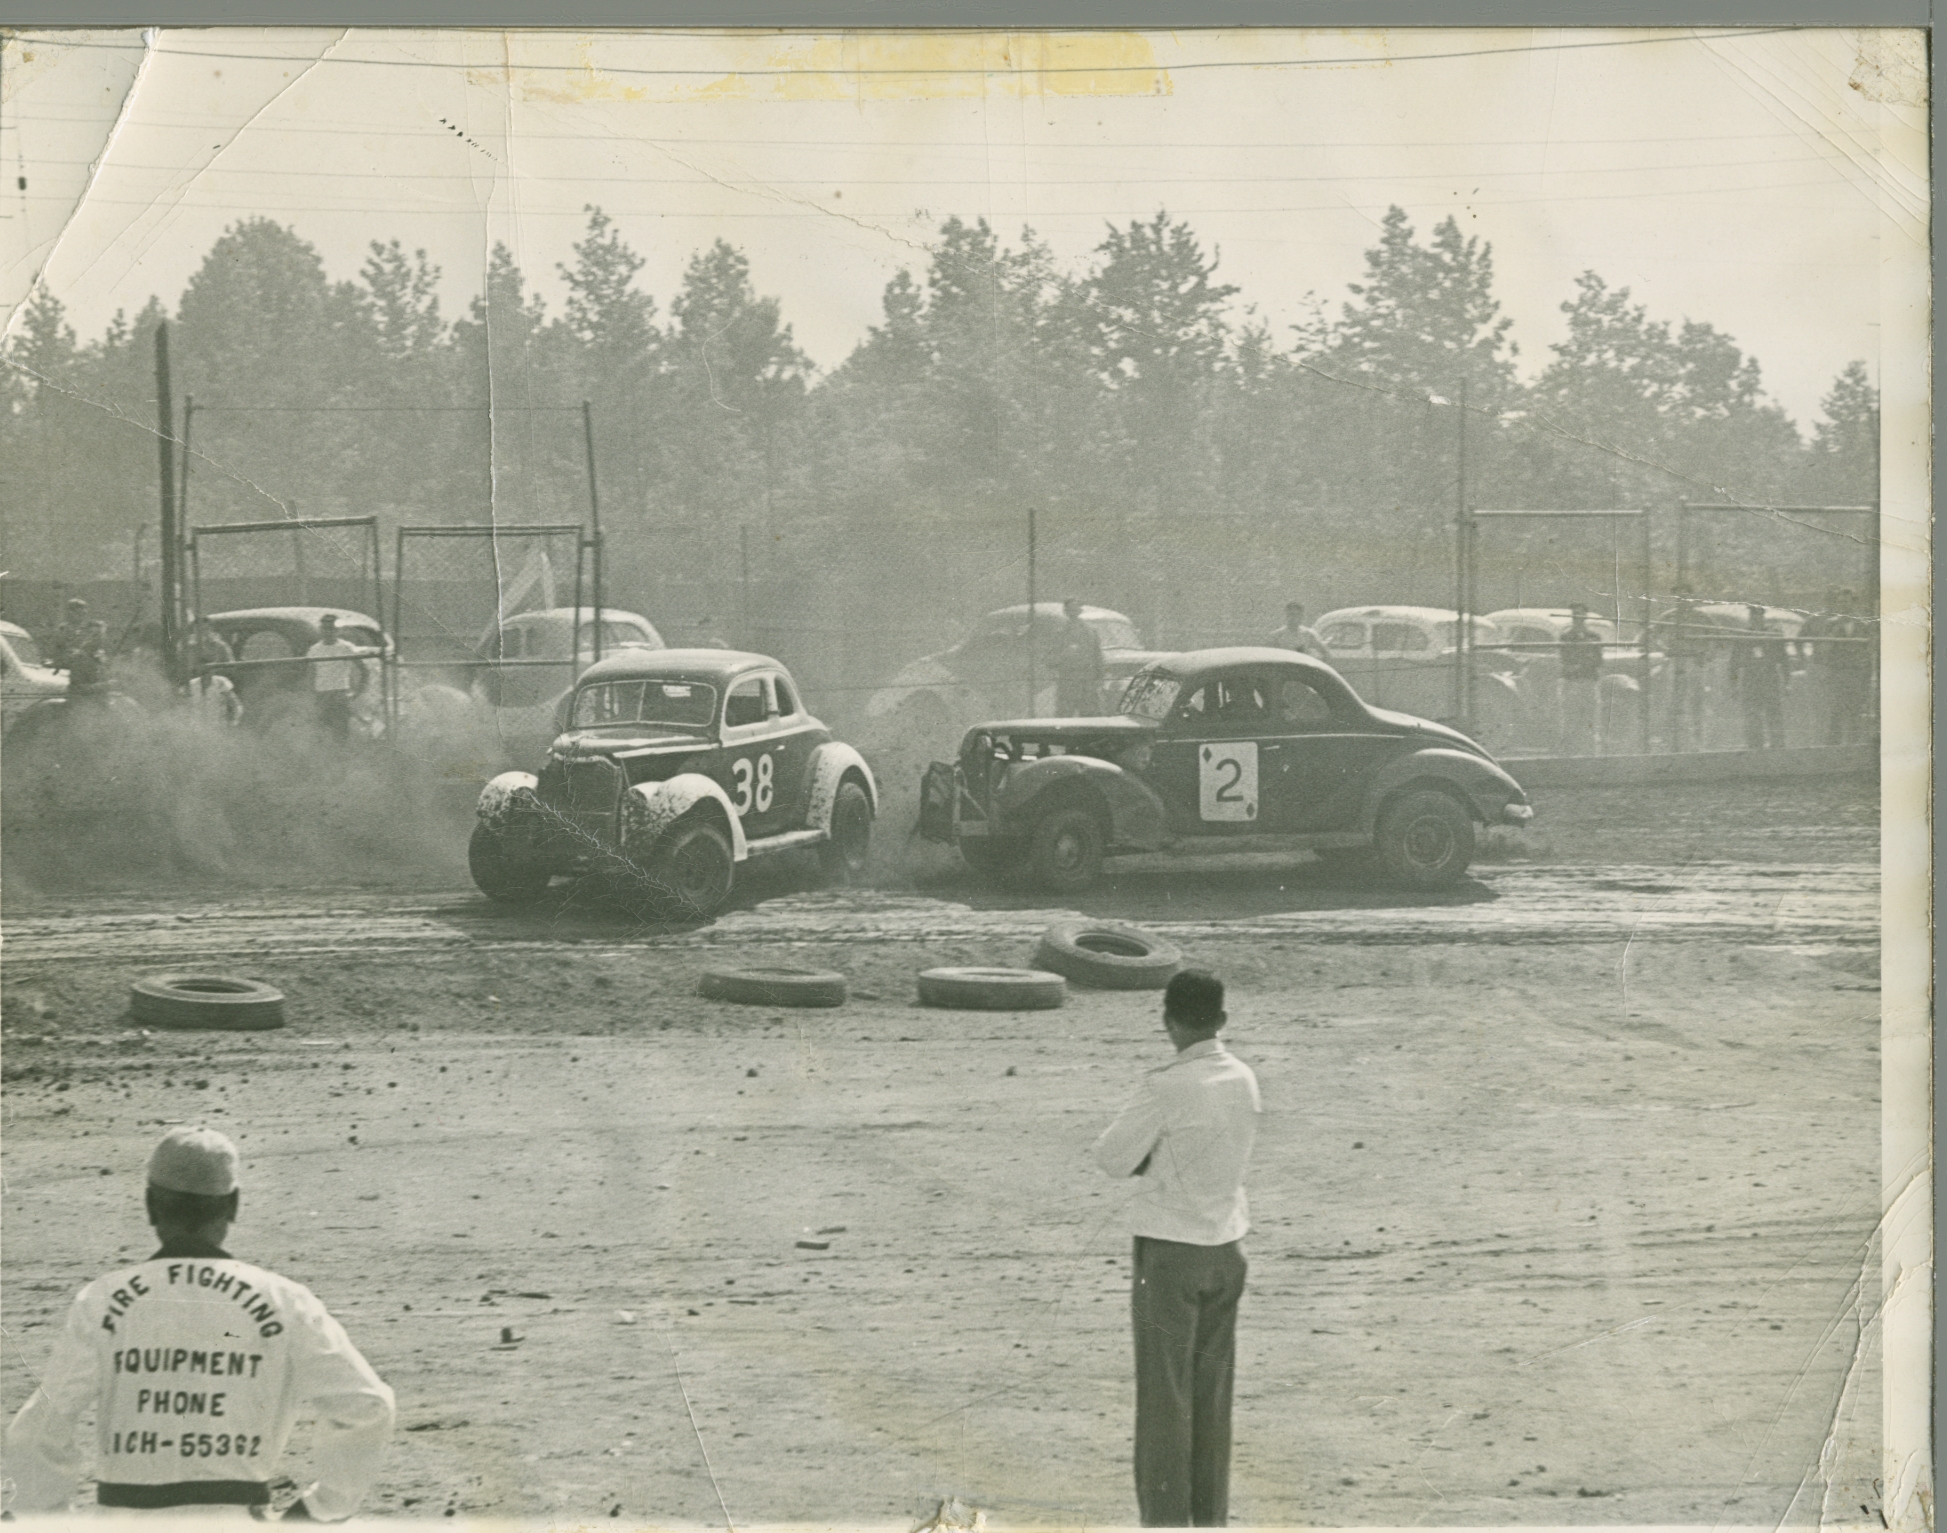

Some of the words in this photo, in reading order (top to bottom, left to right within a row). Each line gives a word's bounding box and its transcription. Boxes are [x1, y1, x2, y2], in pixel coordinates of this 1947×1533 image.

[732, 753, 774, 817] 38
[1216, 758, 1244, 803] 2
[102, 1274, 150, 1335] FIRE
[167, 1264, 283, 1338] FIGHTING
[138, 1389, 226, 1416] PHONE
